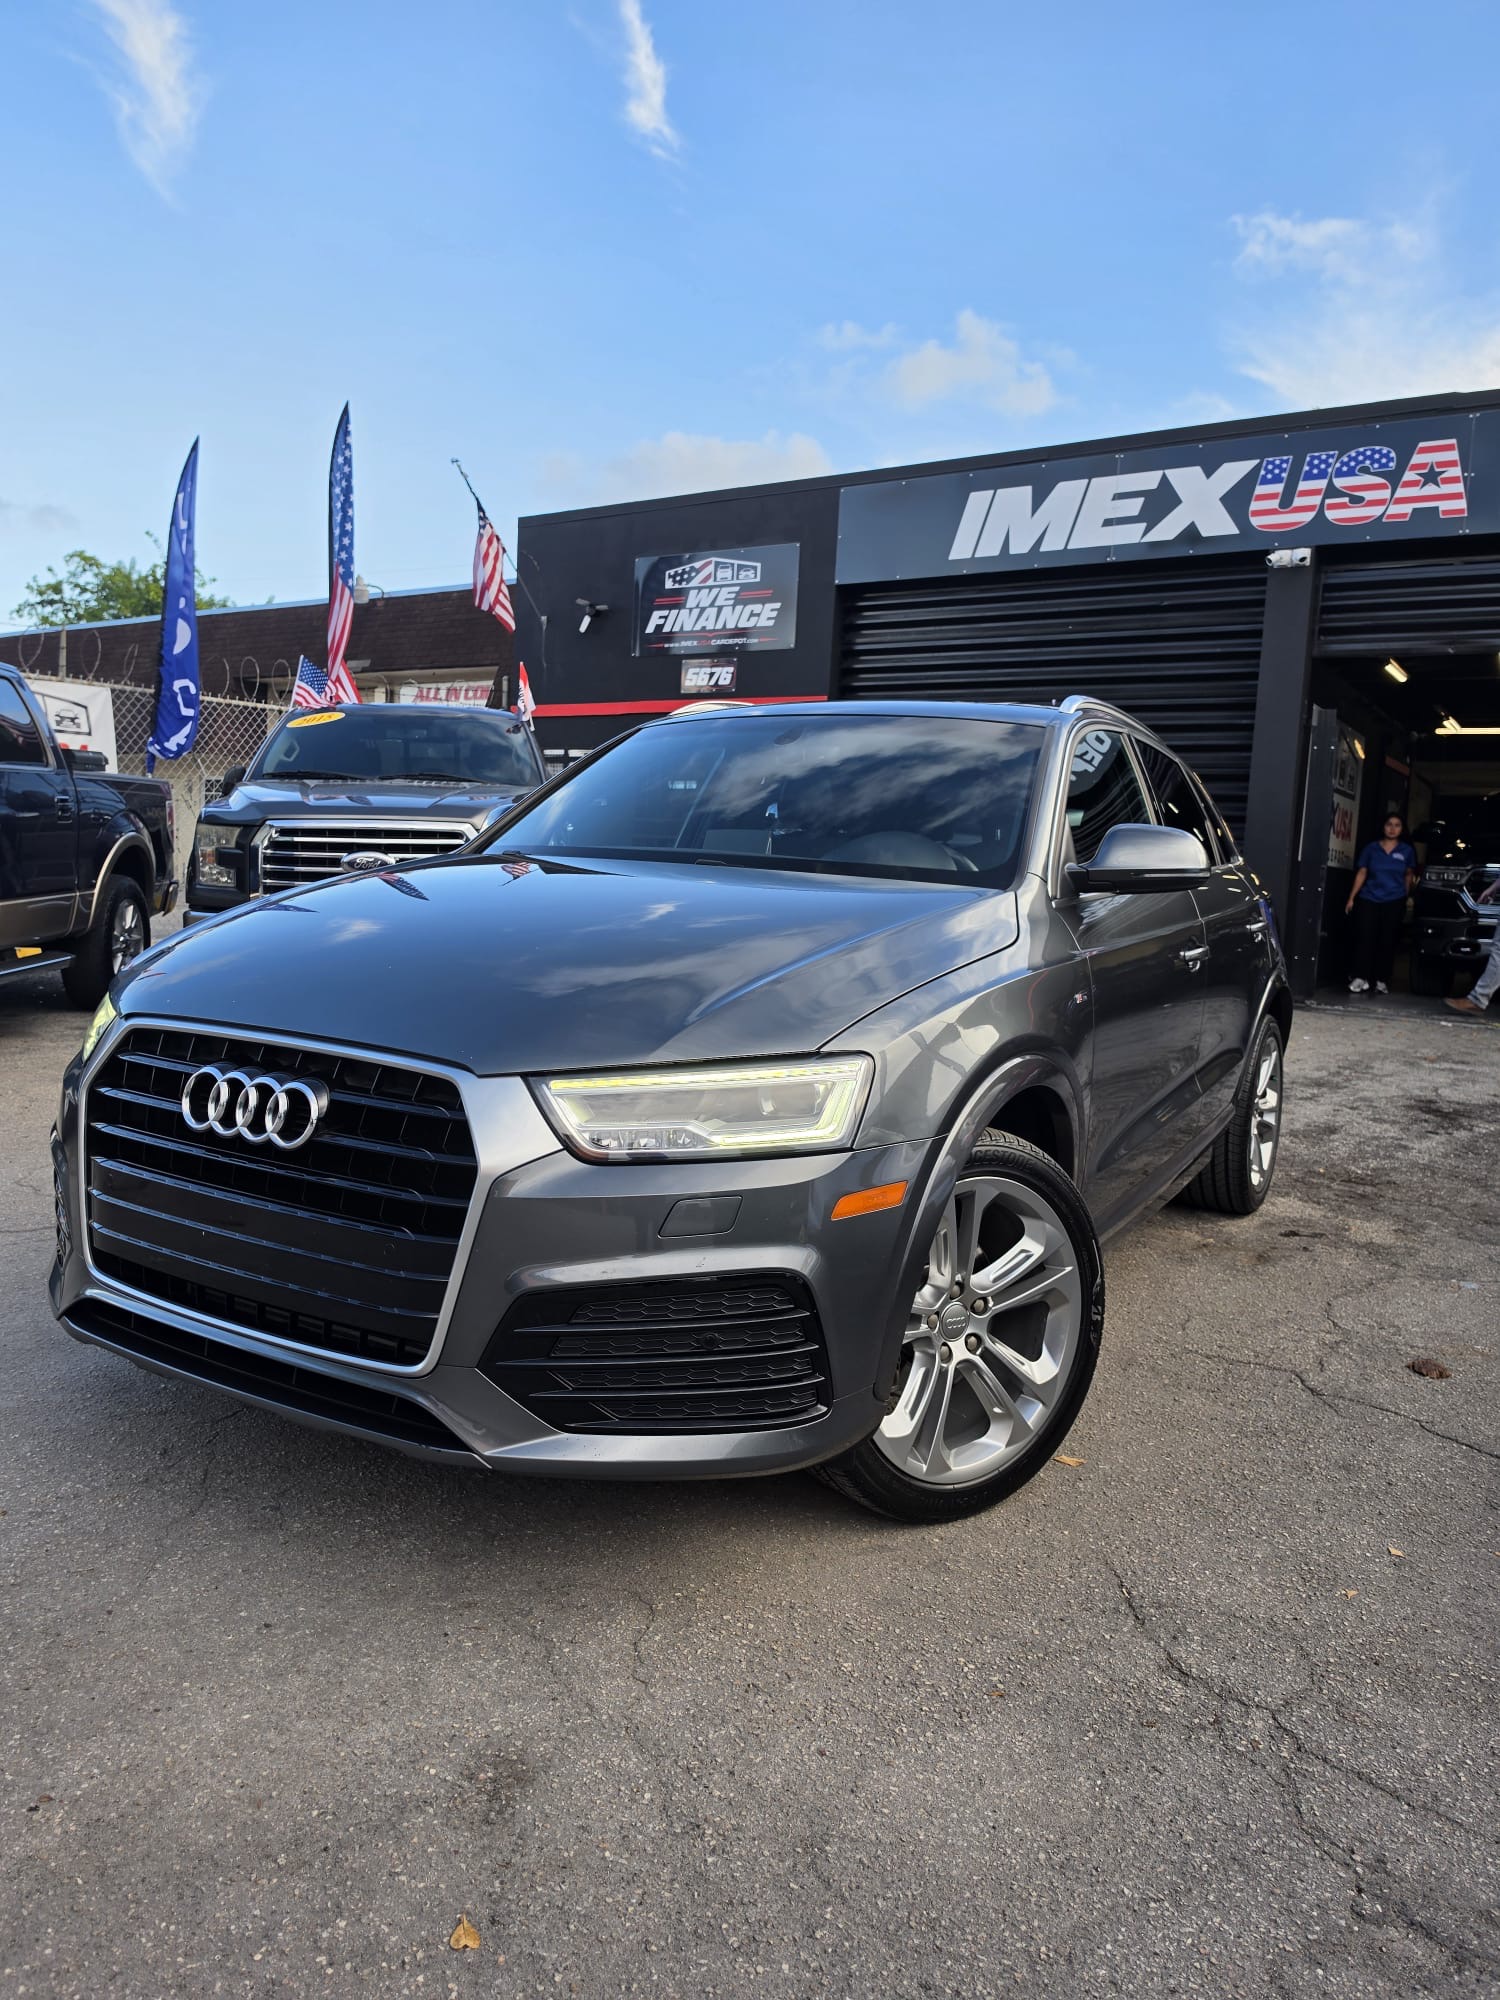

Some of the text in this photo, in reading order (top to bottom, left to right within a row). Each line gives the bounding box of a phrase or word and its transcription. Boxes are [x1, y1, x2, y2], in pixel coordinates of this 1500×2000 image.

[685, 586, 741, 609] WE
[645, 602, 782, 634] FINANCE
[685, 667, 735, 686] 5676
[412, 687, 440, 704] ALL
[446, 687, 462, 702] IN
[353, 857, 382, 870] Ford
